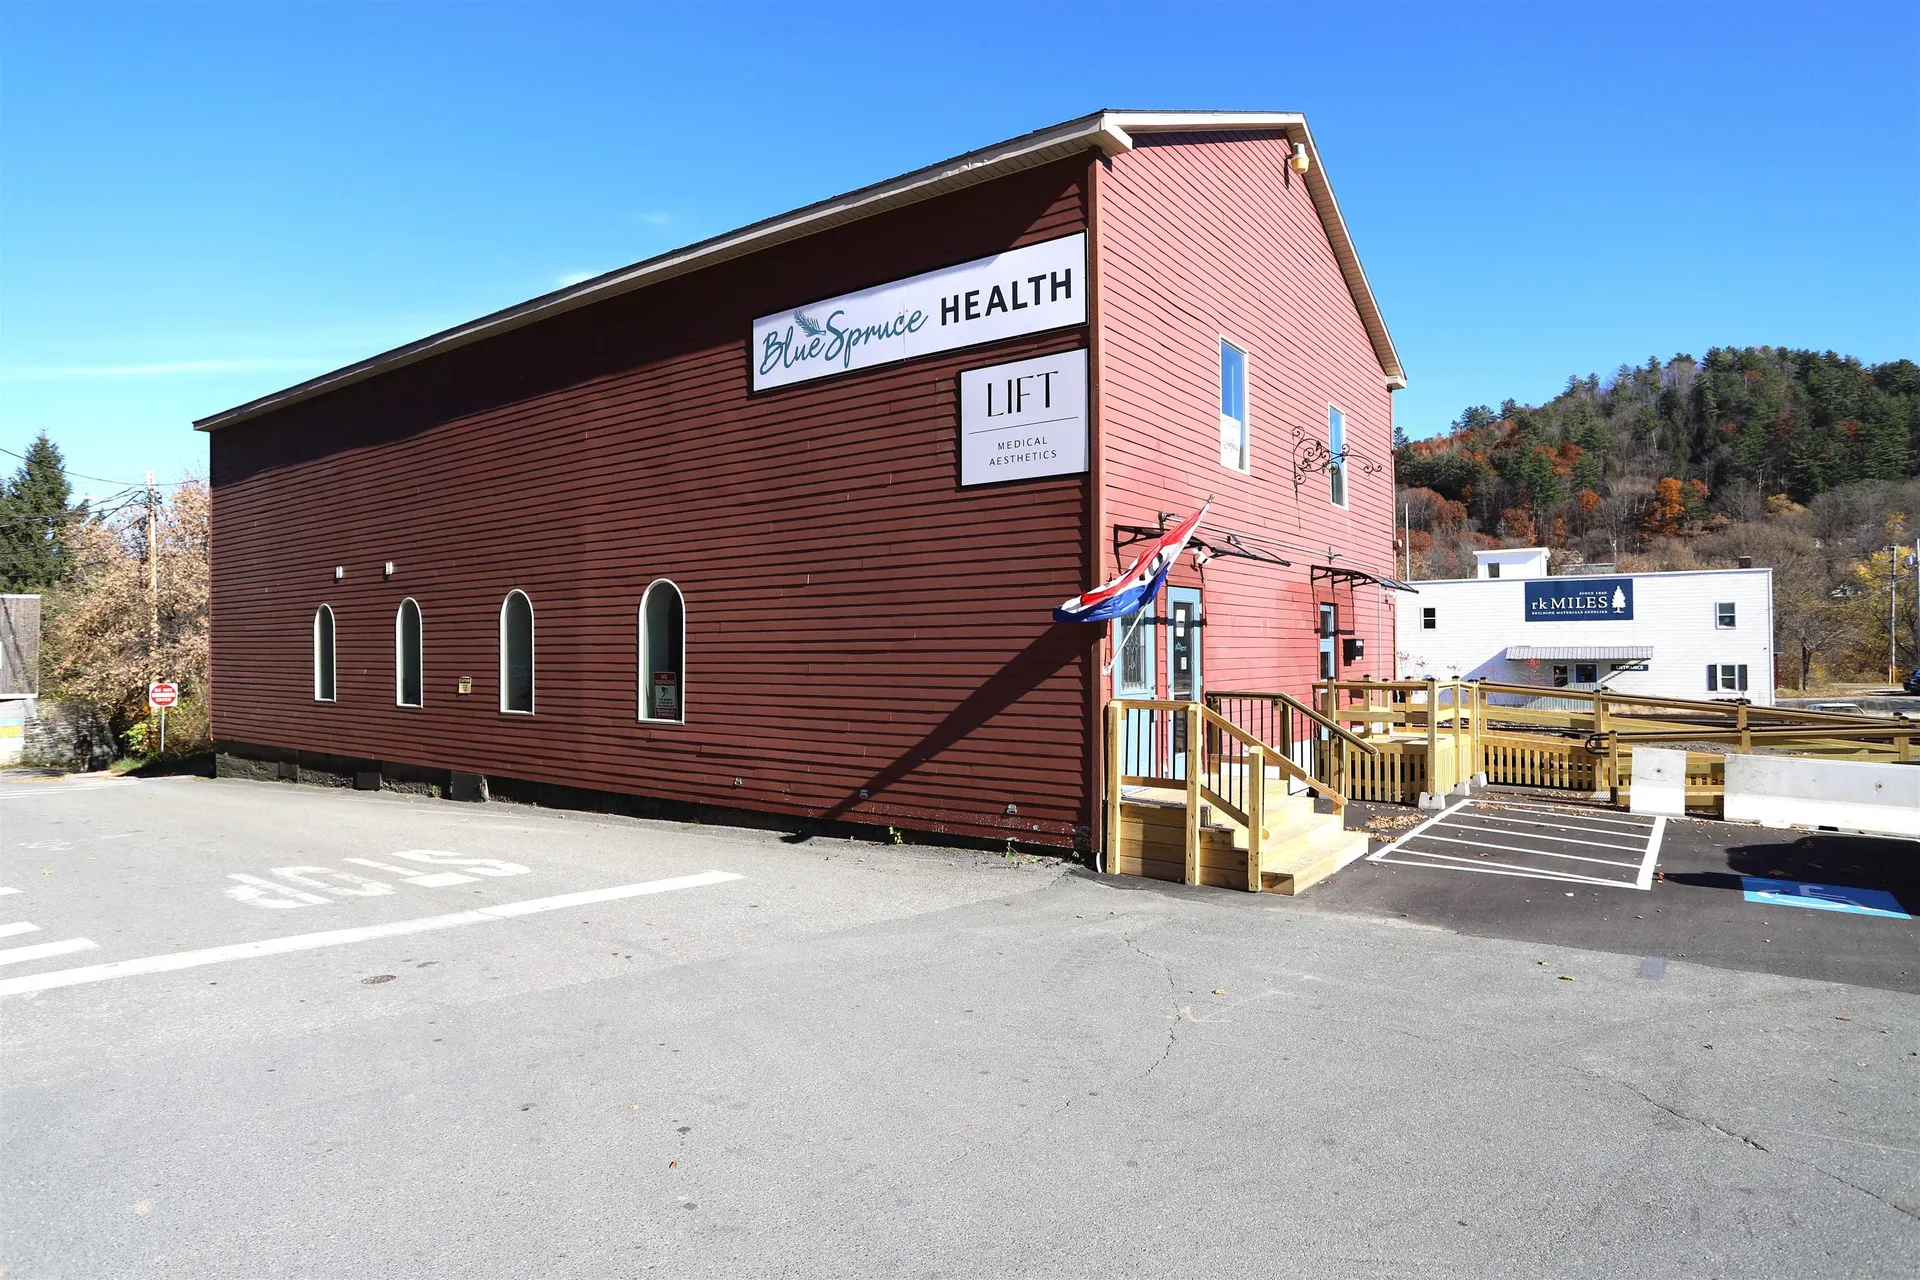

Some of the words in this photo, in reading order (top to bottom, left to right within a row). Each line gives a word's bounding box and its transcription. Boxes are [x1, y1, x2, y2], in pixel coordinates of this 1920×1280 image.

[759, 325, 826, 376] Blue
[824, 309, 929, 369] Spruce
[940, 267, 1073, 326] HEALTH
[987, 370, 1060, 418] LIFT
[997, 435, 1049, 451] MEDICAL
[988, 449, 1058, 467] AESTHETICS
[1531, 597, 1548, 610] rk
[1550, 596, 1608, 609] MILES
